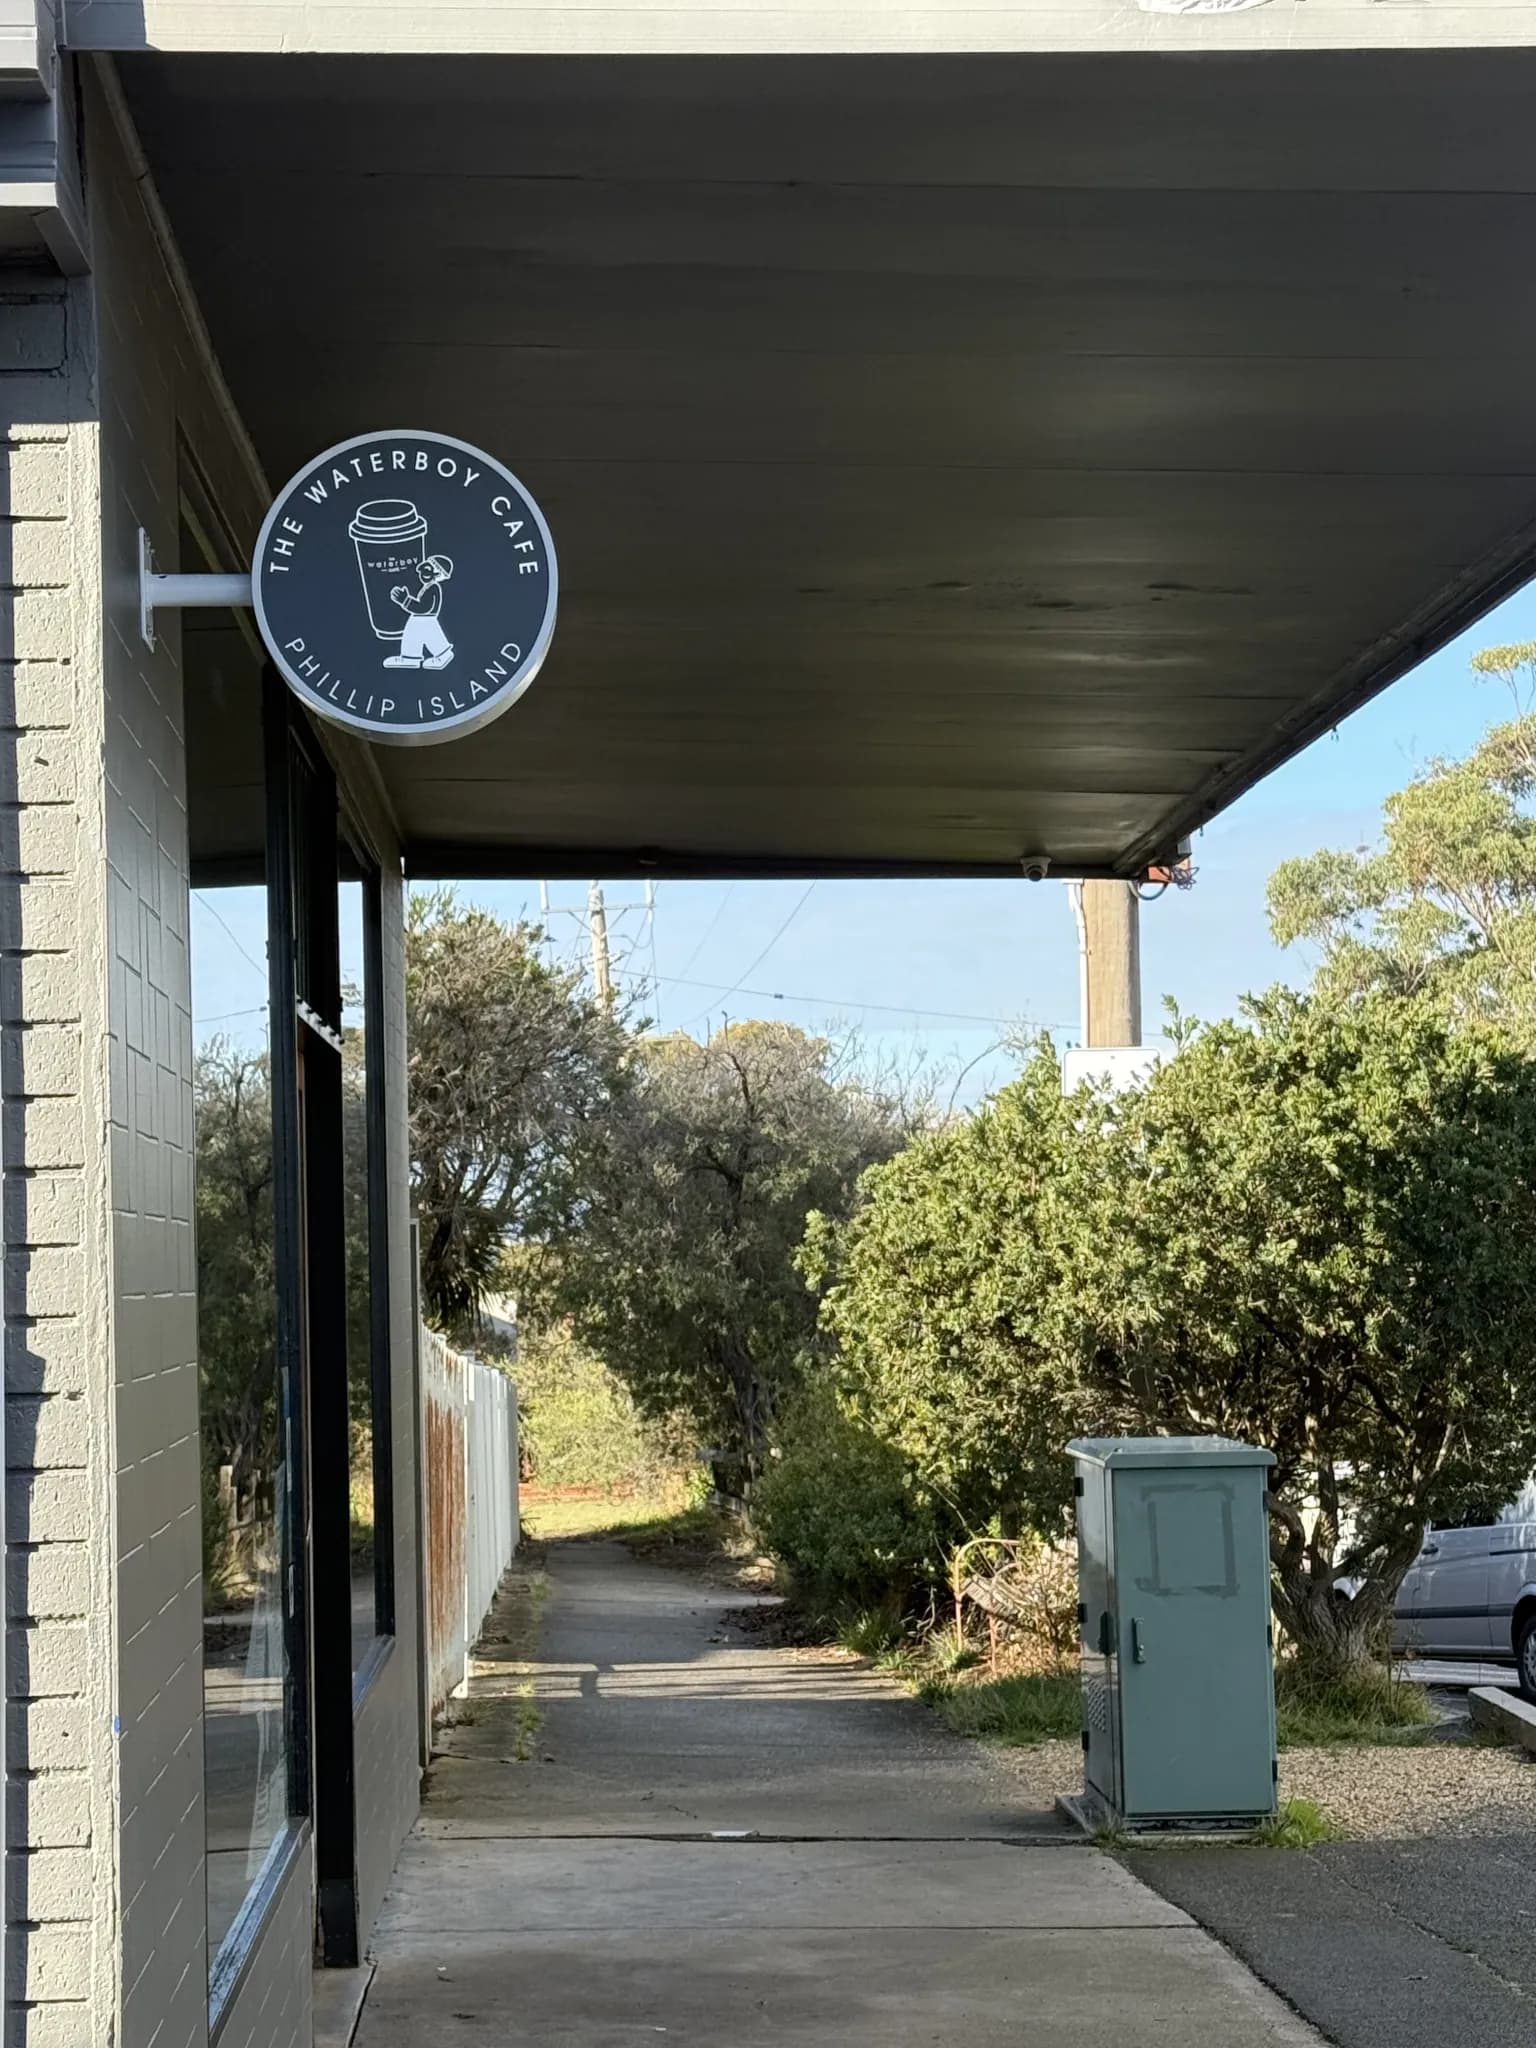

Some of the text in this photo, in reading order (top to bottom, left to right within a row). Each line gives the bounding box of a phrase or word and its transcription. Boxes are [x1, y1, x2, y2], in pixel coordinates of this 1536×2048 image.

[270, 450, 539, 574] THE WATERBOY CAFE
[285, 637, 521, 718] PHILLIP ISLAND
